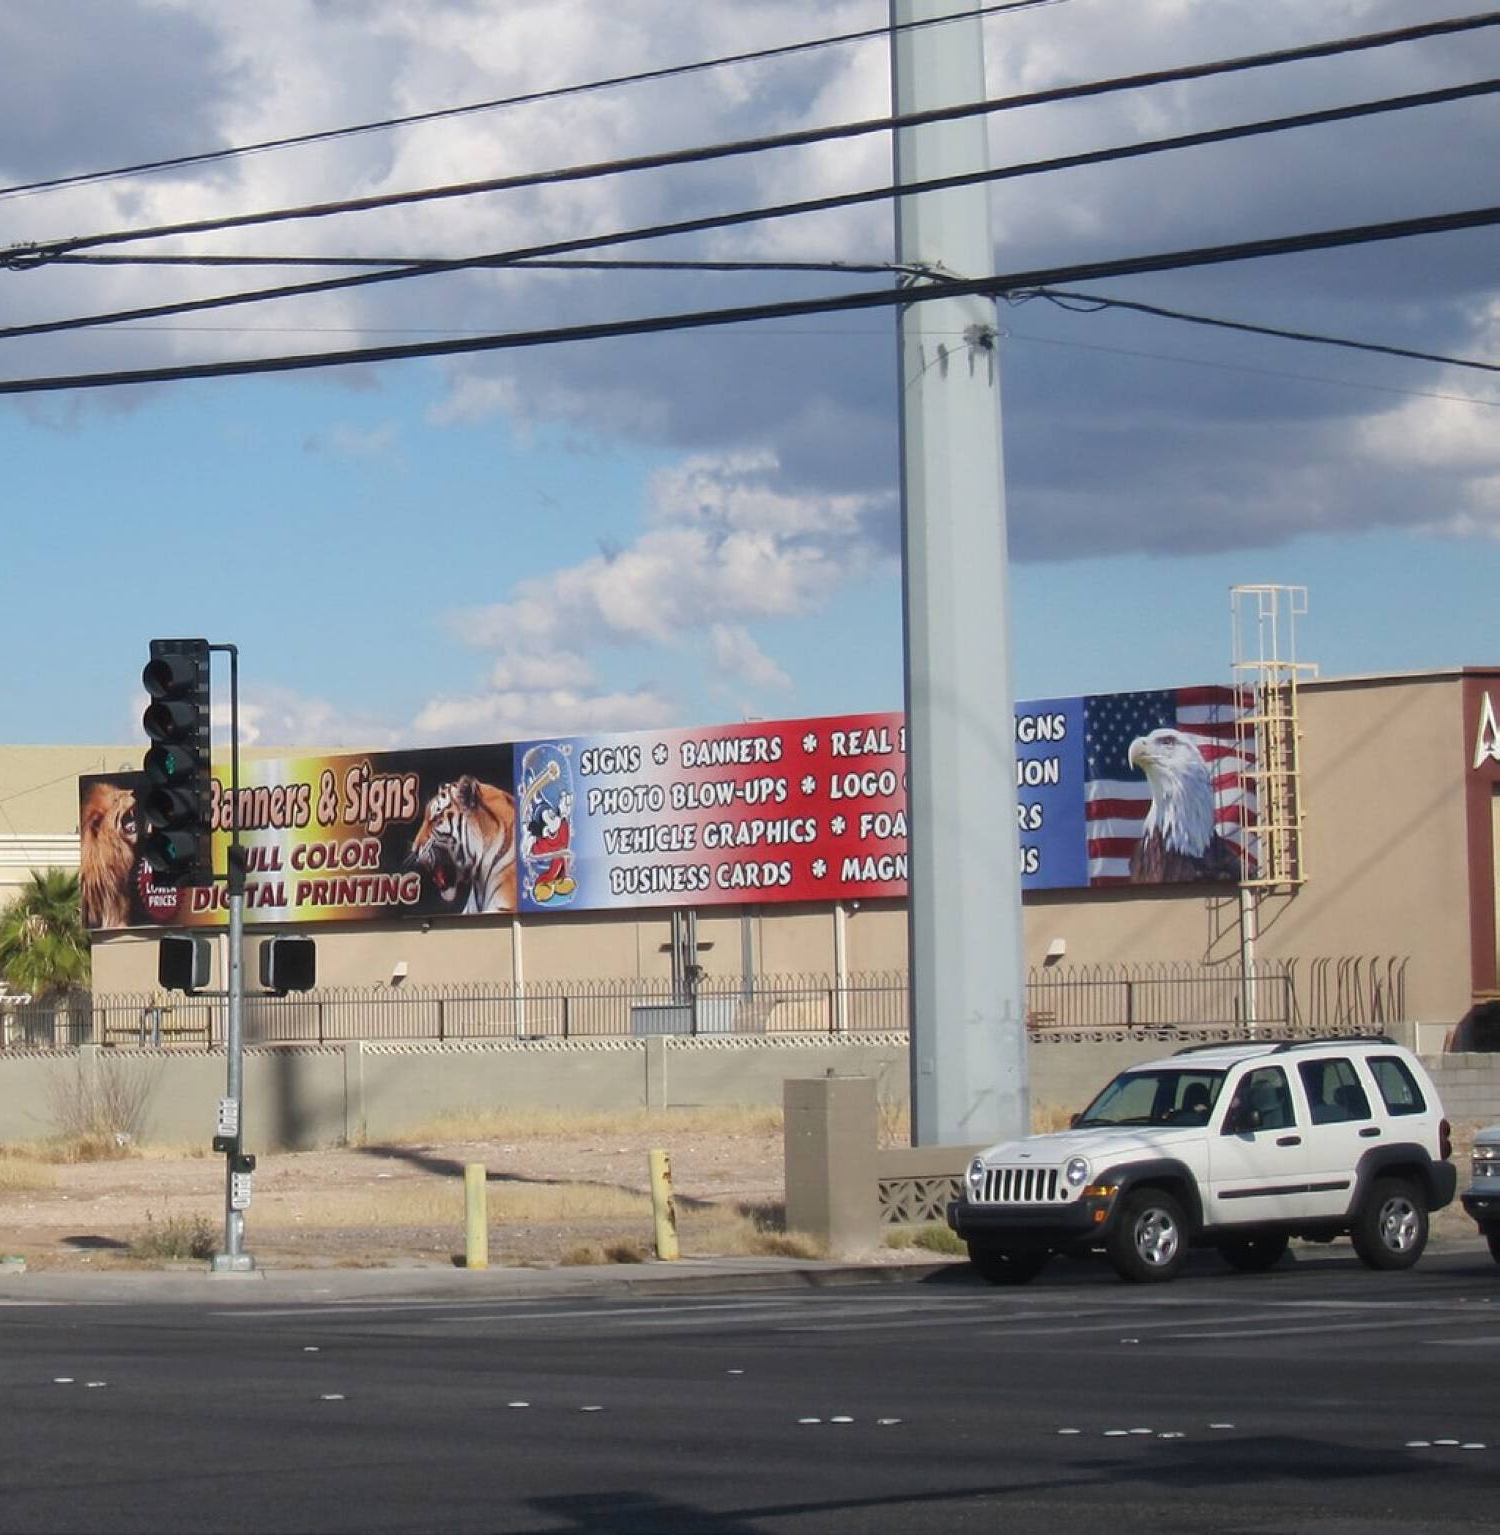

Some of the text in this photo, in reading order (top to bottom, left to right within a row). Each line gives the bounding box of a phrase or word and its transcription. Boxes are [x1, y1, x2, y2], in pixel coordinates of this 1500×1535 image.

[580, 746, 641, 776] SIGNS
[680, 736, 783, 769] BANNERS
[830, 727, 893, 757] REAL
[211, 762, 419, 836] Banners & Signs
[588, 785, 665, 815] PHOTO
[670, 776, 788, 810] BLOW-UPS
[830, 769, 896, 799] LOGO
[604, 810, 907, 854] VEHICLE GRAPHICS FOA
[244, 837, 382, 873] ULL COLOR
[610, 854, 908, 894] BUSINESS CARDS MAGN
[192, 872, 421, 913] DIGTAL PRINTING
